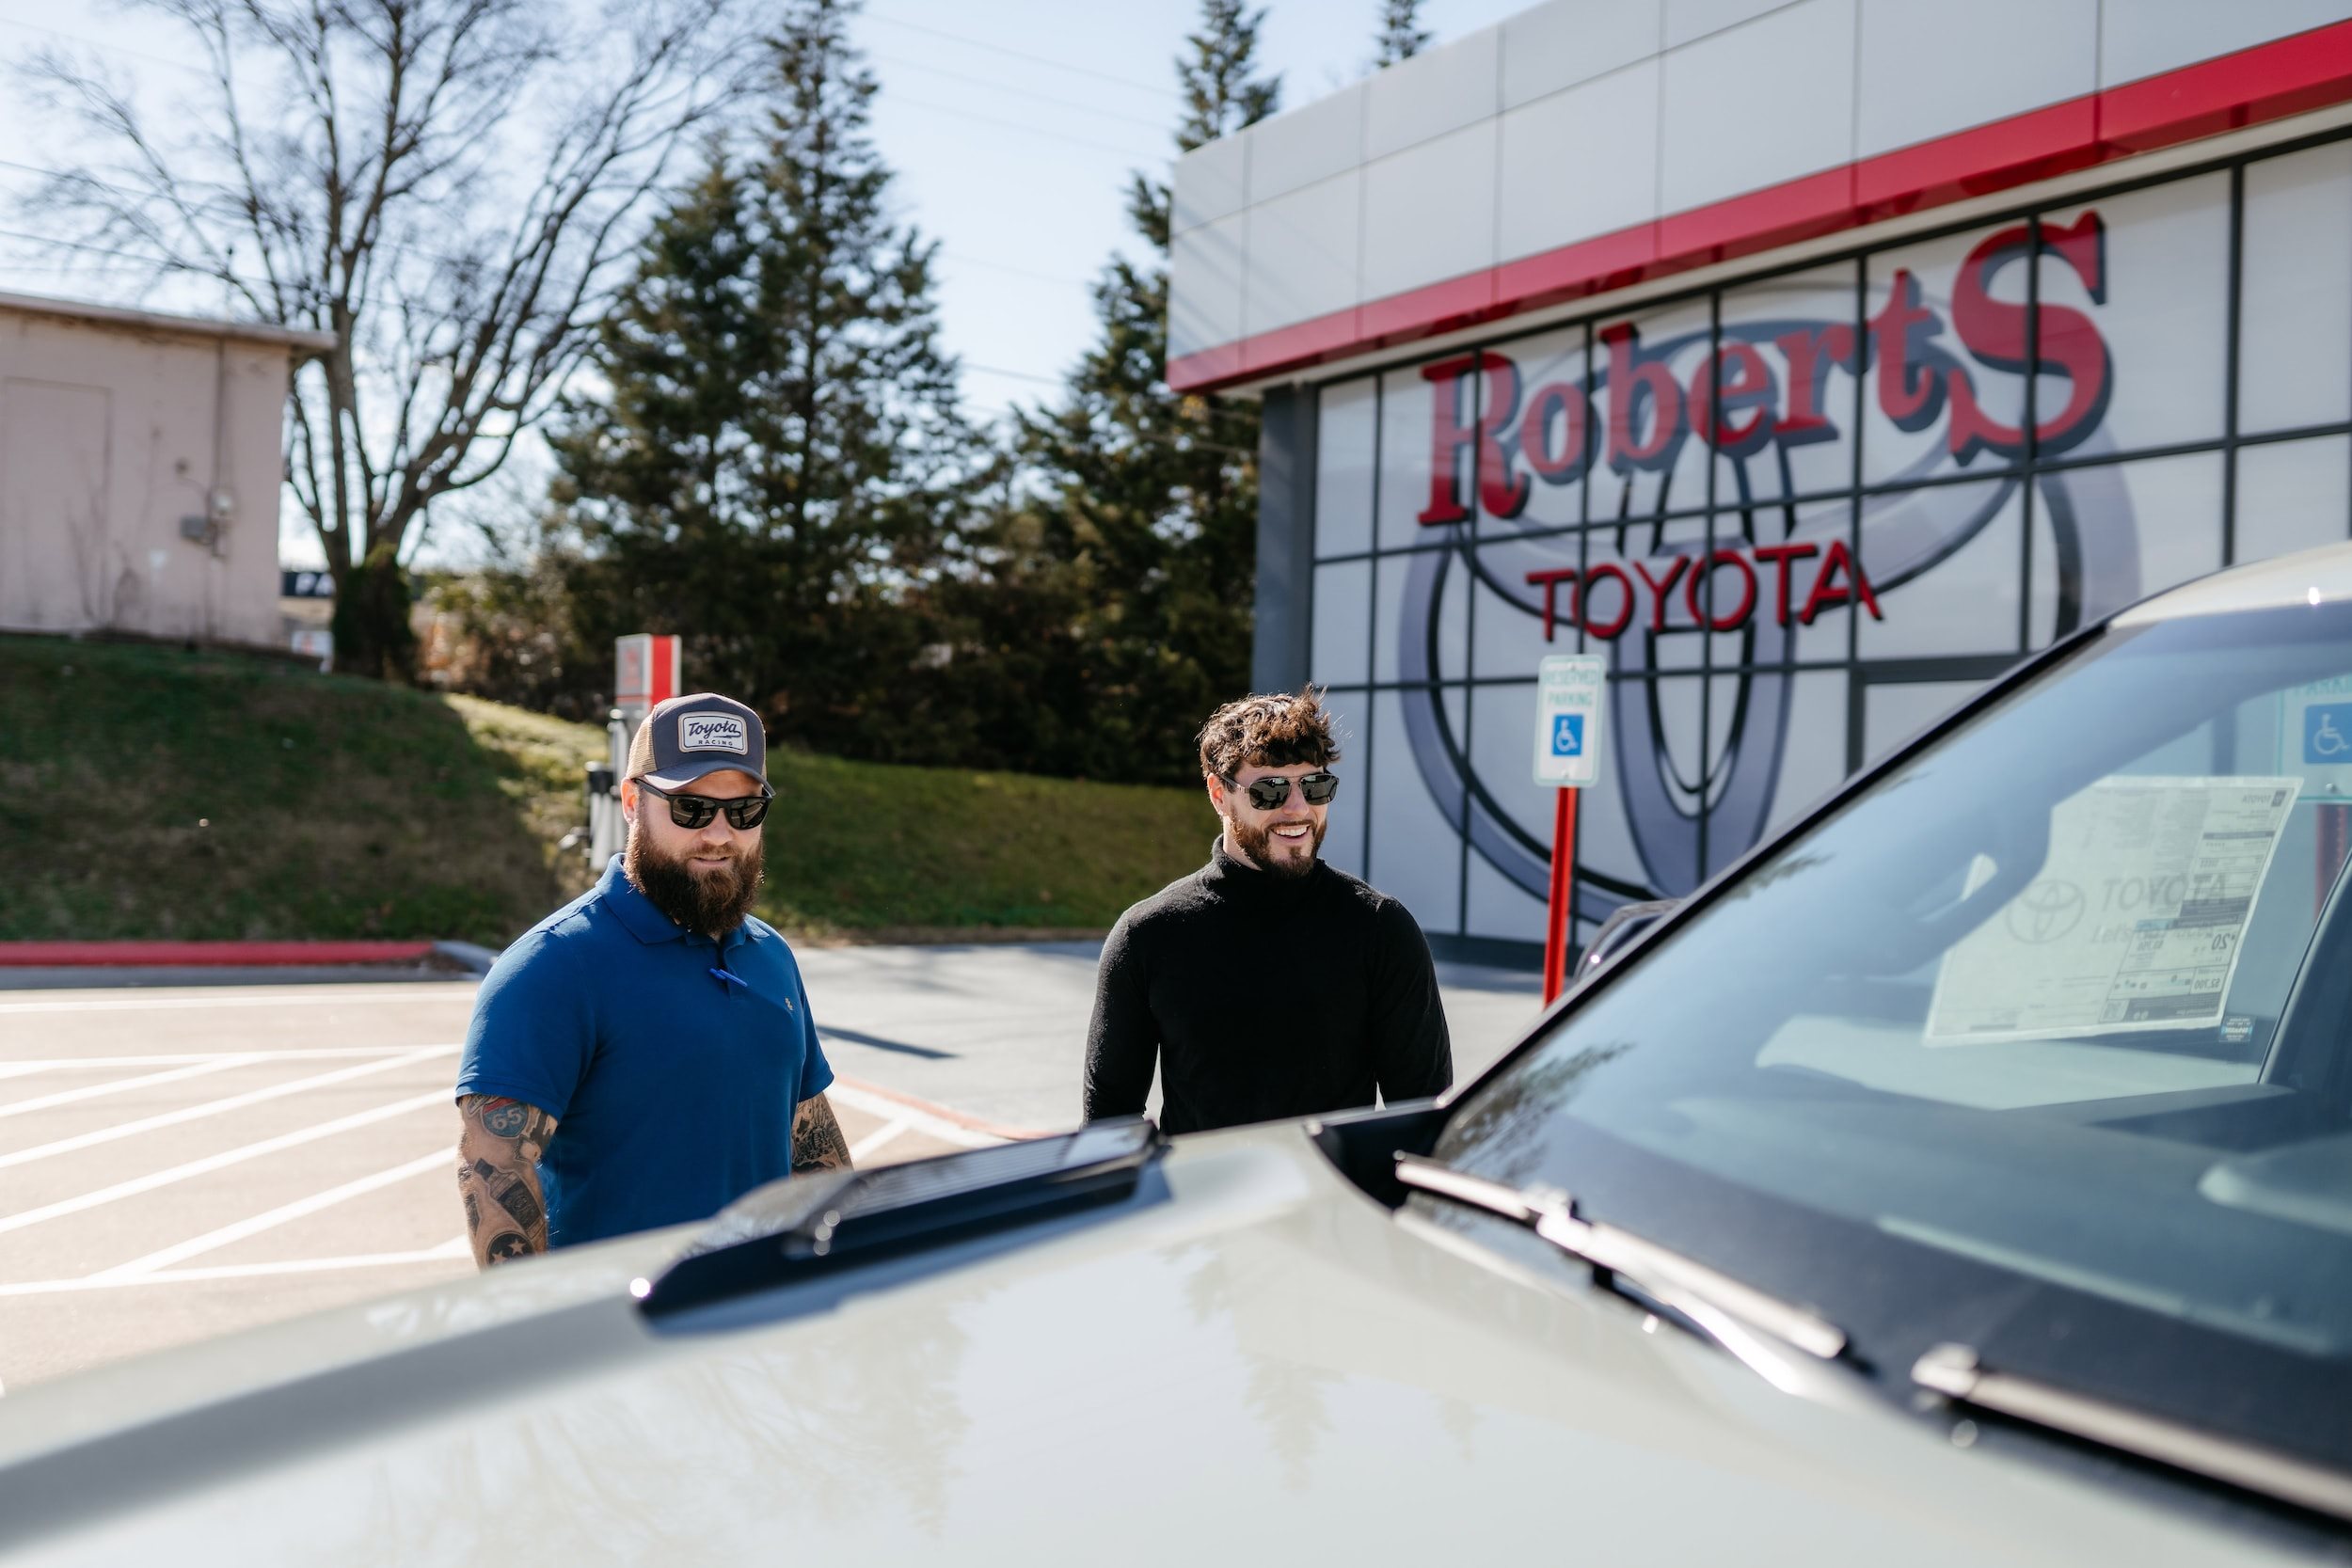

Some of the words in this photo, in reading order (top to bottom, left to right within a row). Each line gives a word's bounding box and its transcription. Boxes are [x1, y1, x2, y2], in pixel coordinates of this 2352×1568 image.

[1526, 541, 1884, 641] TOYOTA
[1549, 691, 1593, 707] PARKING
[689, 721, 741, 739] Toyota
[2101, 872, 2226, 912] TOYOTA
[492, 1108, 522, 1129] 65
